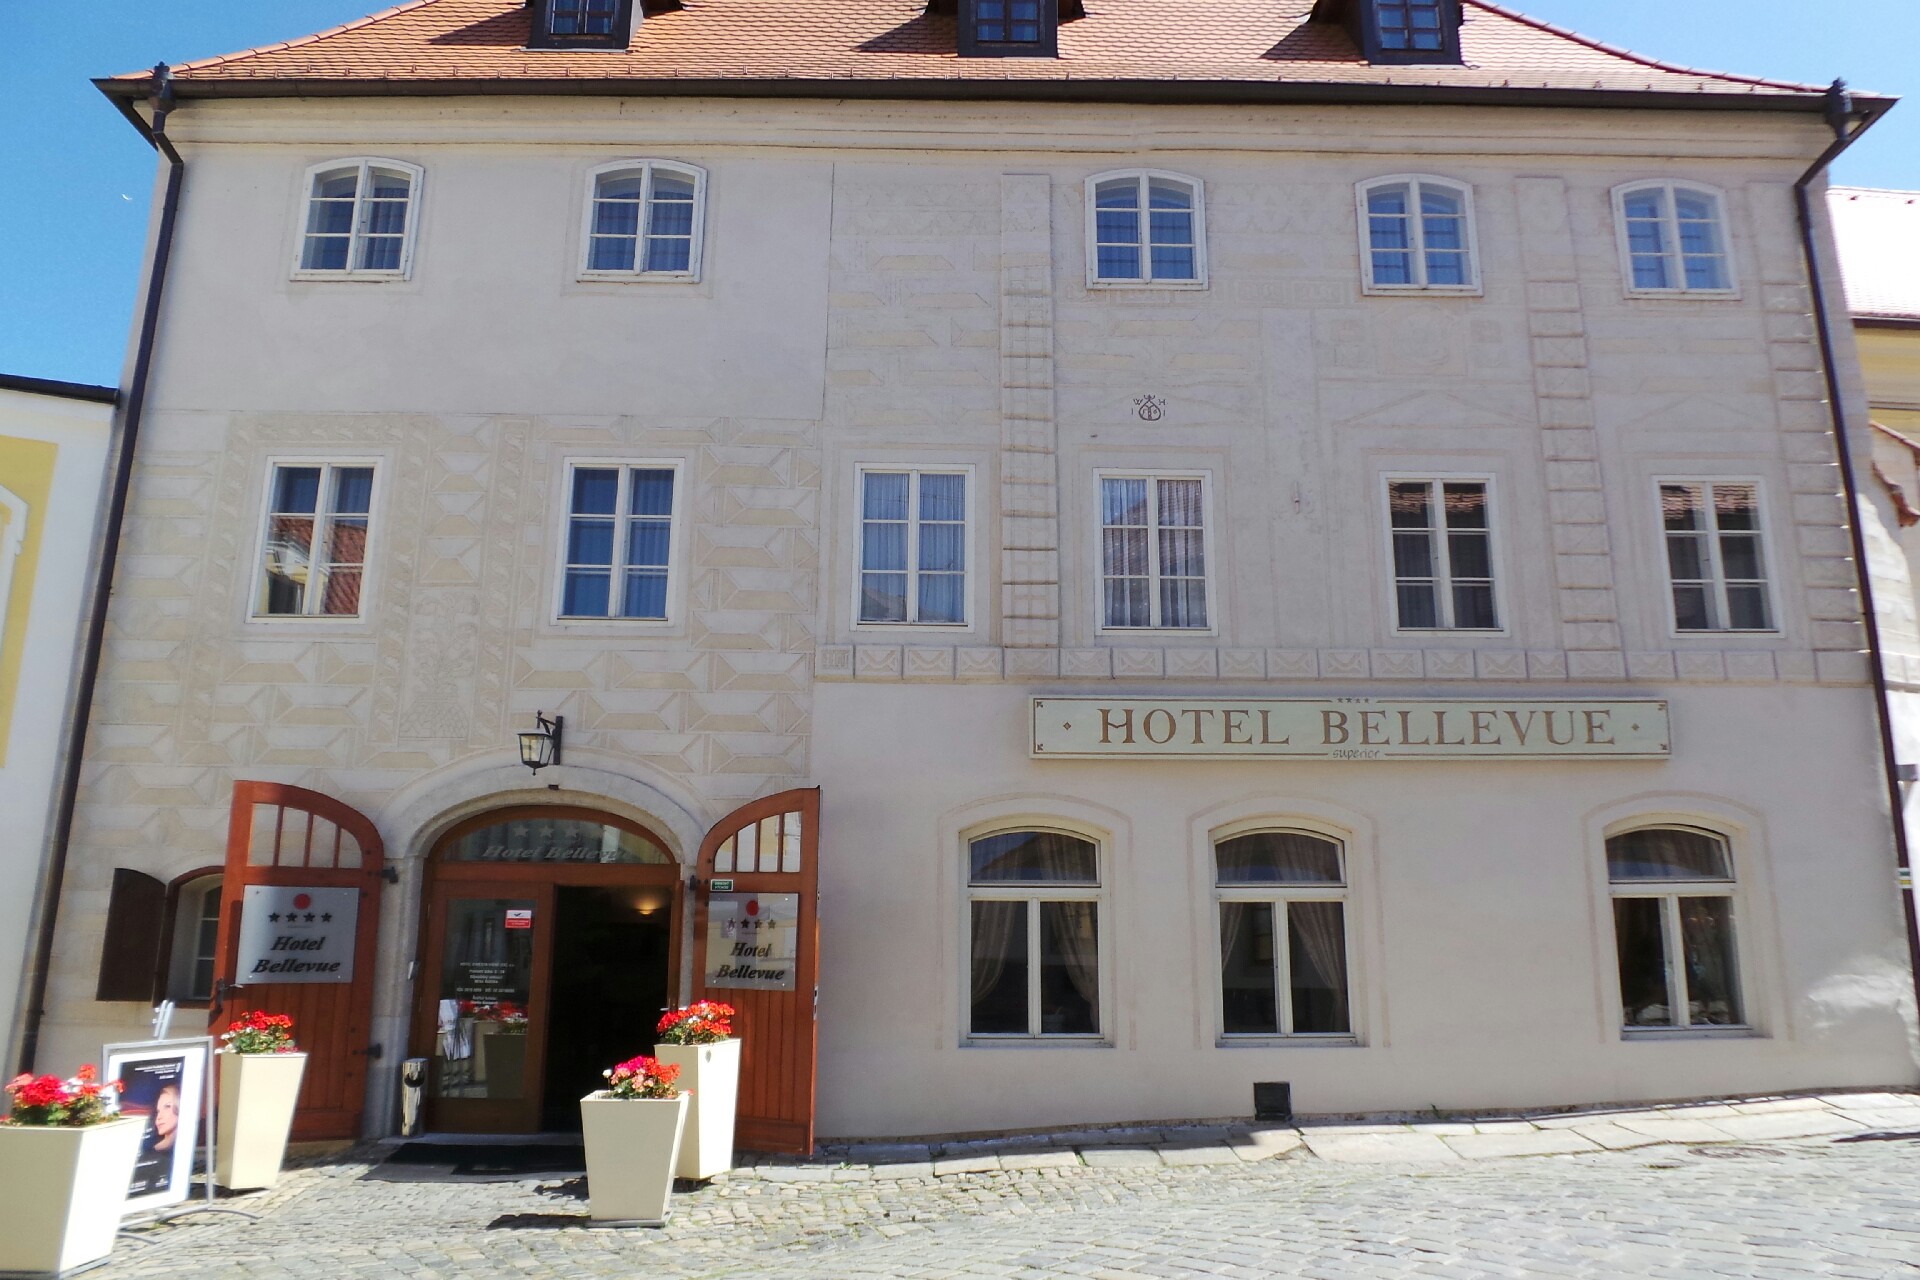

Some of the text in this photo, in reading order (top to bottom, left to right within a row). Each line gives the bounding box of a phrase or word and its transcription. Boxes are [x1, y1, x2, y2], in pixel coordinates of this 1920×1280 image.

[1097, 708, 1615, 746] HOTEL BELLEVUE
[1333, 748, 1381, 760] superior
[482, 845, 632, 861] Hotel Bellev
[270, 936, 326, 951] Hotel
[730, 942, 772, 957] Hotel
[251, 958, 341, 973] Bellevue
[716, 964, 785, 980] Bellevue
